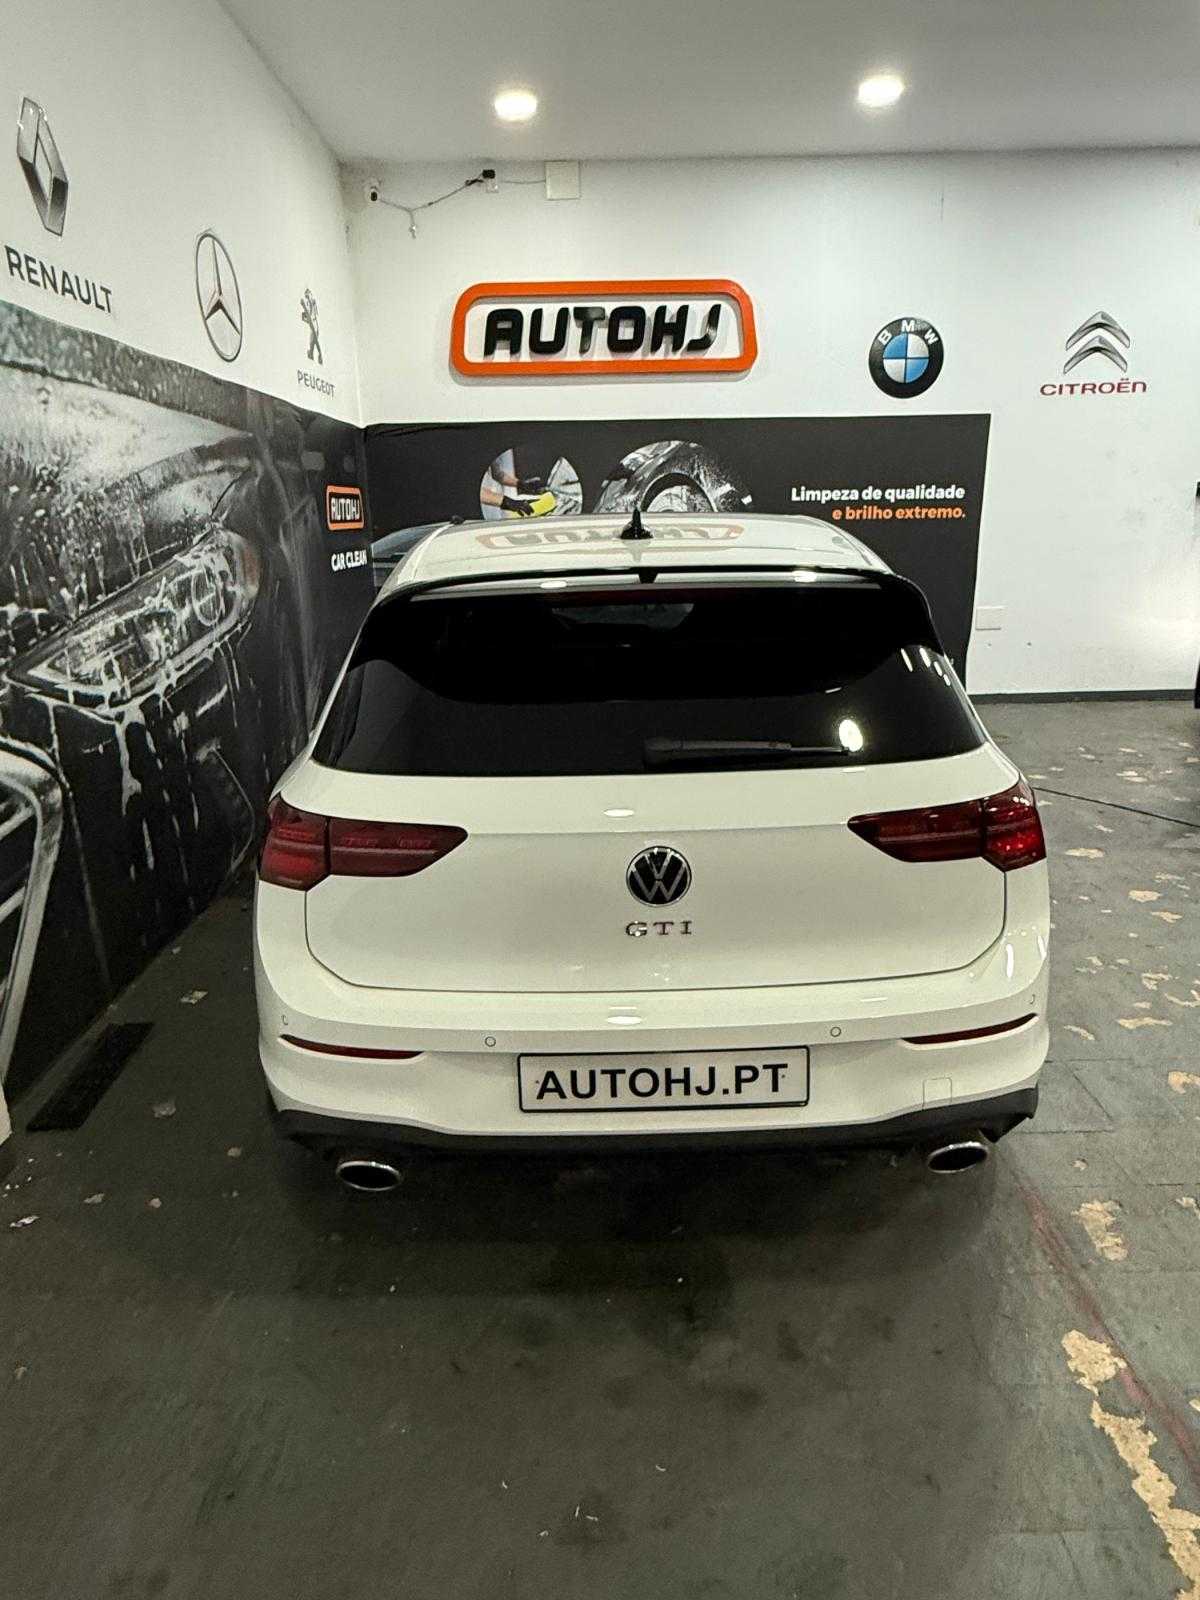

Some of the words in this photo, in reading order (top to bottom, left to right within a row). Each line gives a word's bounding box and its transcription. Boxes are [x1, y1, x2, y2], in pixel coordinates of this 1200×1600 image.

[4, 245, 112, 313] RENAULT
[482, 303, 722, 358] AUTOHJ
[877, 319, 939, 346] BMW
[296, 368, 336, 398] PEUGEOT
[791, 485, 859, 504] Limpeza
[861, 485, 883, 501] de
[884, 483, 966, 503] qualidade
[331, 498, 360, 521] AUTOHJ
[831, 508, 842, 521] e
[845, 505, 893, 520] brilho
[894, 506, 966, 520] extremo.
[330, 552, 345, 572] CAR
[345, 549, 368, 568] CLEAN
[625, 920, 693, 937] GTI
[535, 1063, 788, 1100] AUTOHJ.PT
